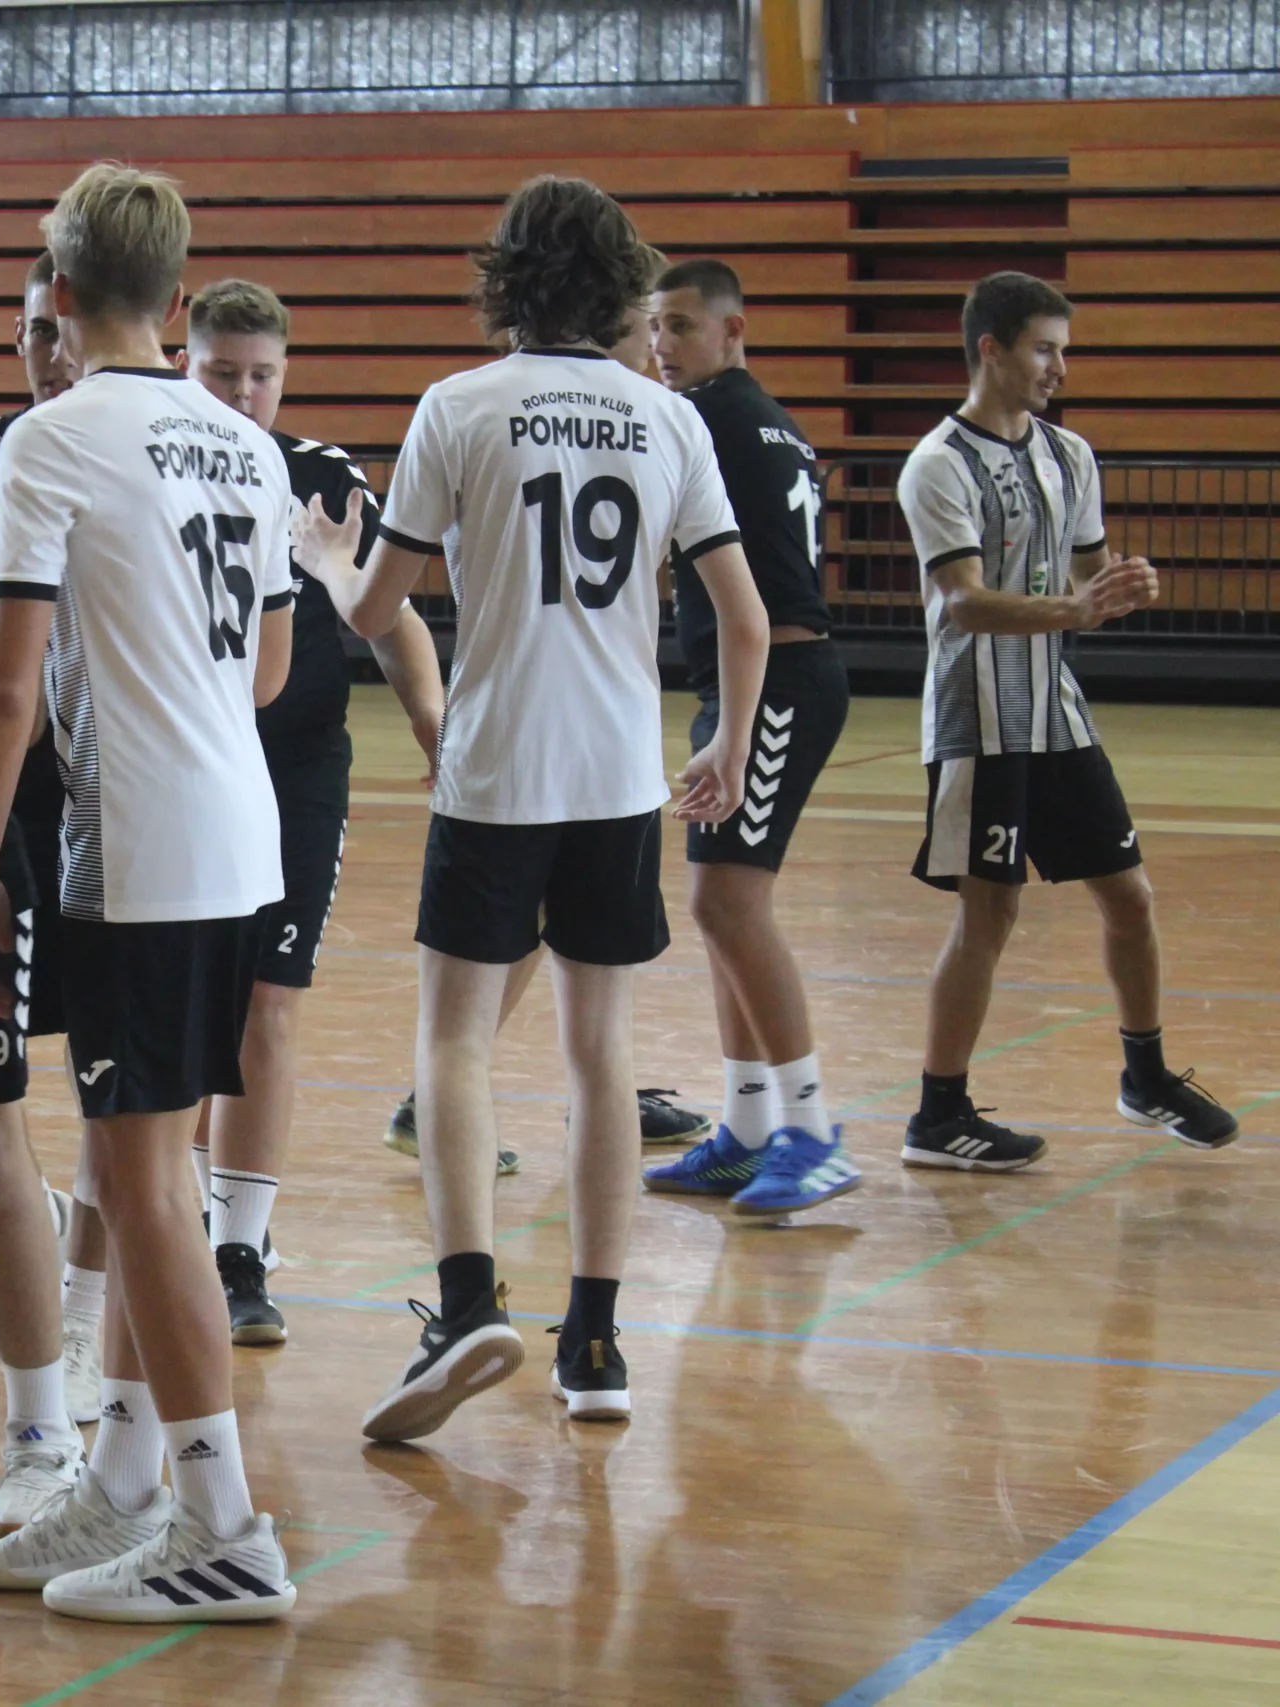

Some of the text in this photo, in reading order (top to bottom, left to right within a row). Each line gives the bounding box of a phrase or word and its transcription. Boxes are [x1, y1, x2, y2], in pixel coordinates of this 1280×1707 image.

[522, 391, 635, 417] ROKOMETNI KLUB
[206, 422, 239, 445] KLUB
[509, 414, 649, 454] POMURJE
[758, 427, 786, 444] RK
[144, 441, 263, 487] POMURJE
[521, 472, 640, 609] 19
[179, 512, 256, 662] 15
[982, 824, 1019, 865] 21
[277, 923, 298, 954] 2
[176, 1450, 219, 1461] adidas
